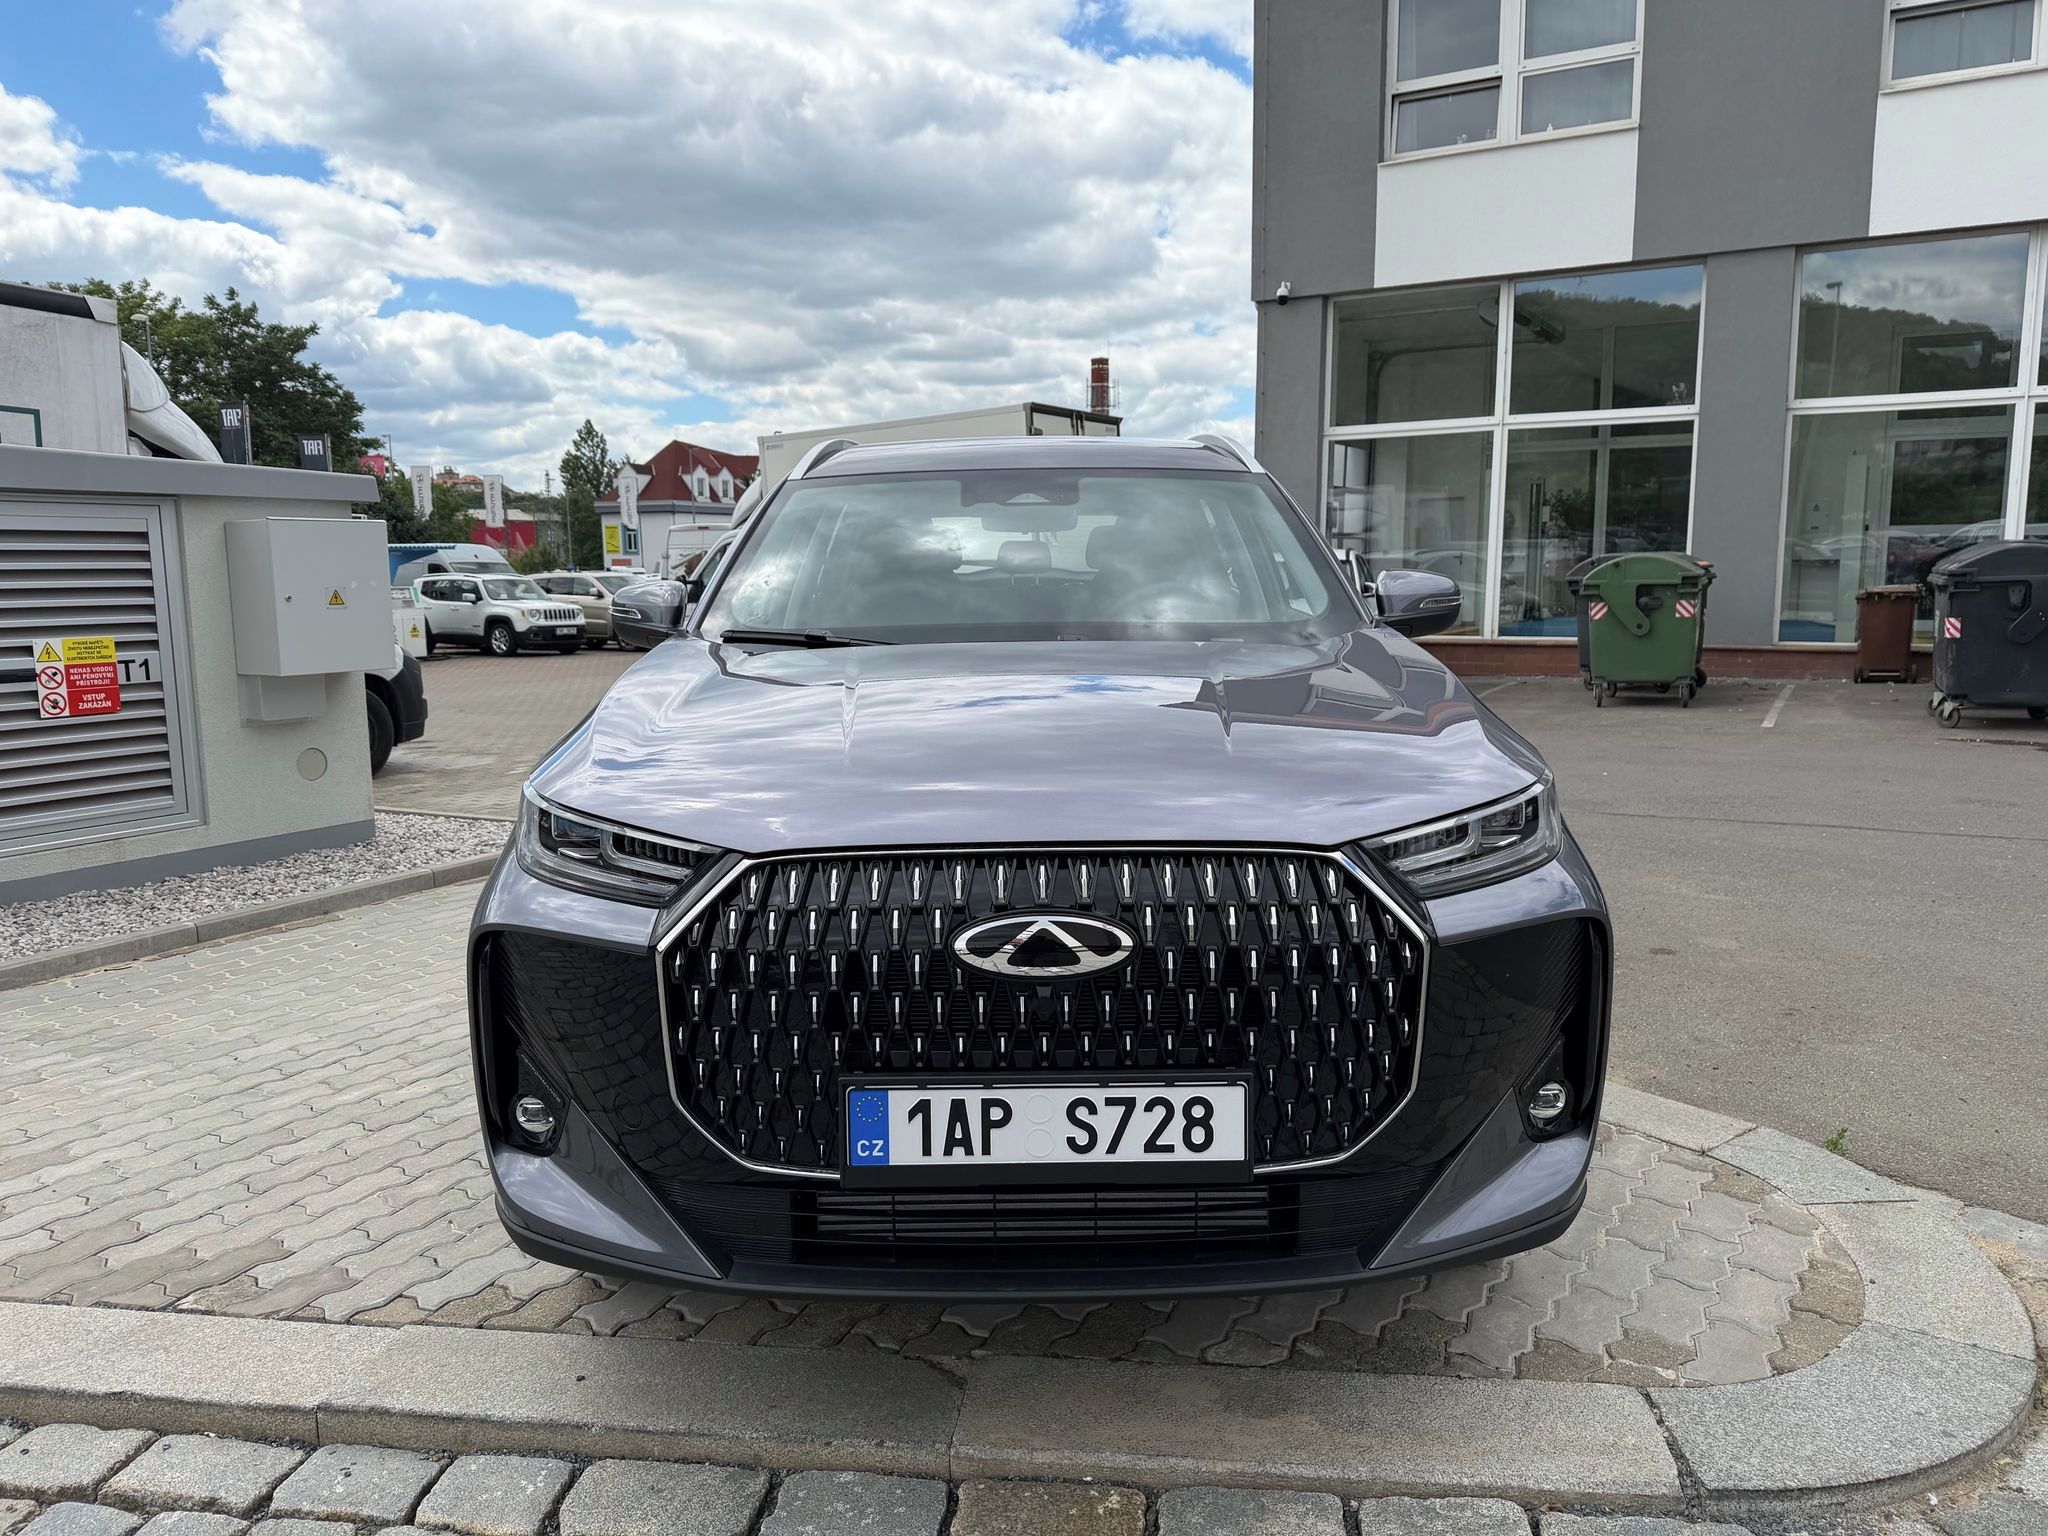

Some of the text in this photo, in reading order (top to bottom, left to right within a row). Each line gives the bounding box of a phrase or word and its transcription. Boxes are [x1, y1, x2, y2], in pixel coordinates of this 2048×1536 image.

[907, 1096, 1215, 1157] 1AP S728
[857, 1139, 884, 1157] CZ
